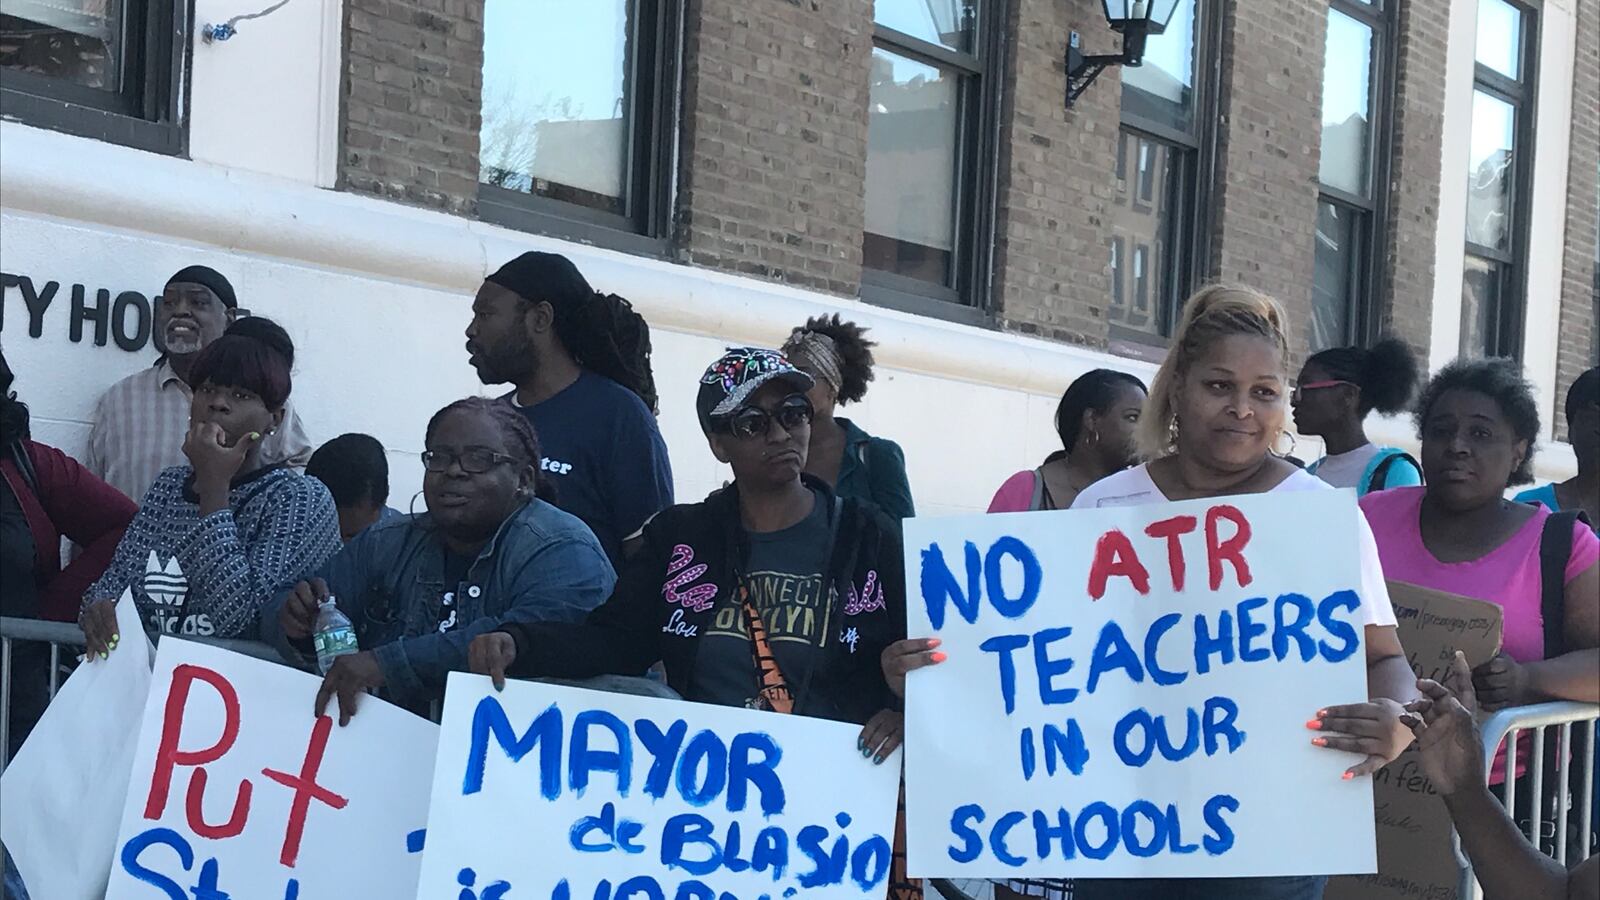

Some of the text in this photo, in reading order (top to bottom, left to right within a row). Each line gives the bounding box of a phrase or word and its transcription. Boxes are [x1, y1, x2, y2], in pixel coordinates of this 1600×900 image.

[920, 535, 1043, 631] NO
[1087, 504, 1253, 602] ATR
[979, 589, 1362, 715] TEACHERS
[144, 664, 348, 868] Put
[462, 695, 787, 819] MAYOR
[1020, 695, 1247, 782] IN OUR
[568, 801, 647, 855] de
[947, 794, 1240, 867] SCHOOLS
